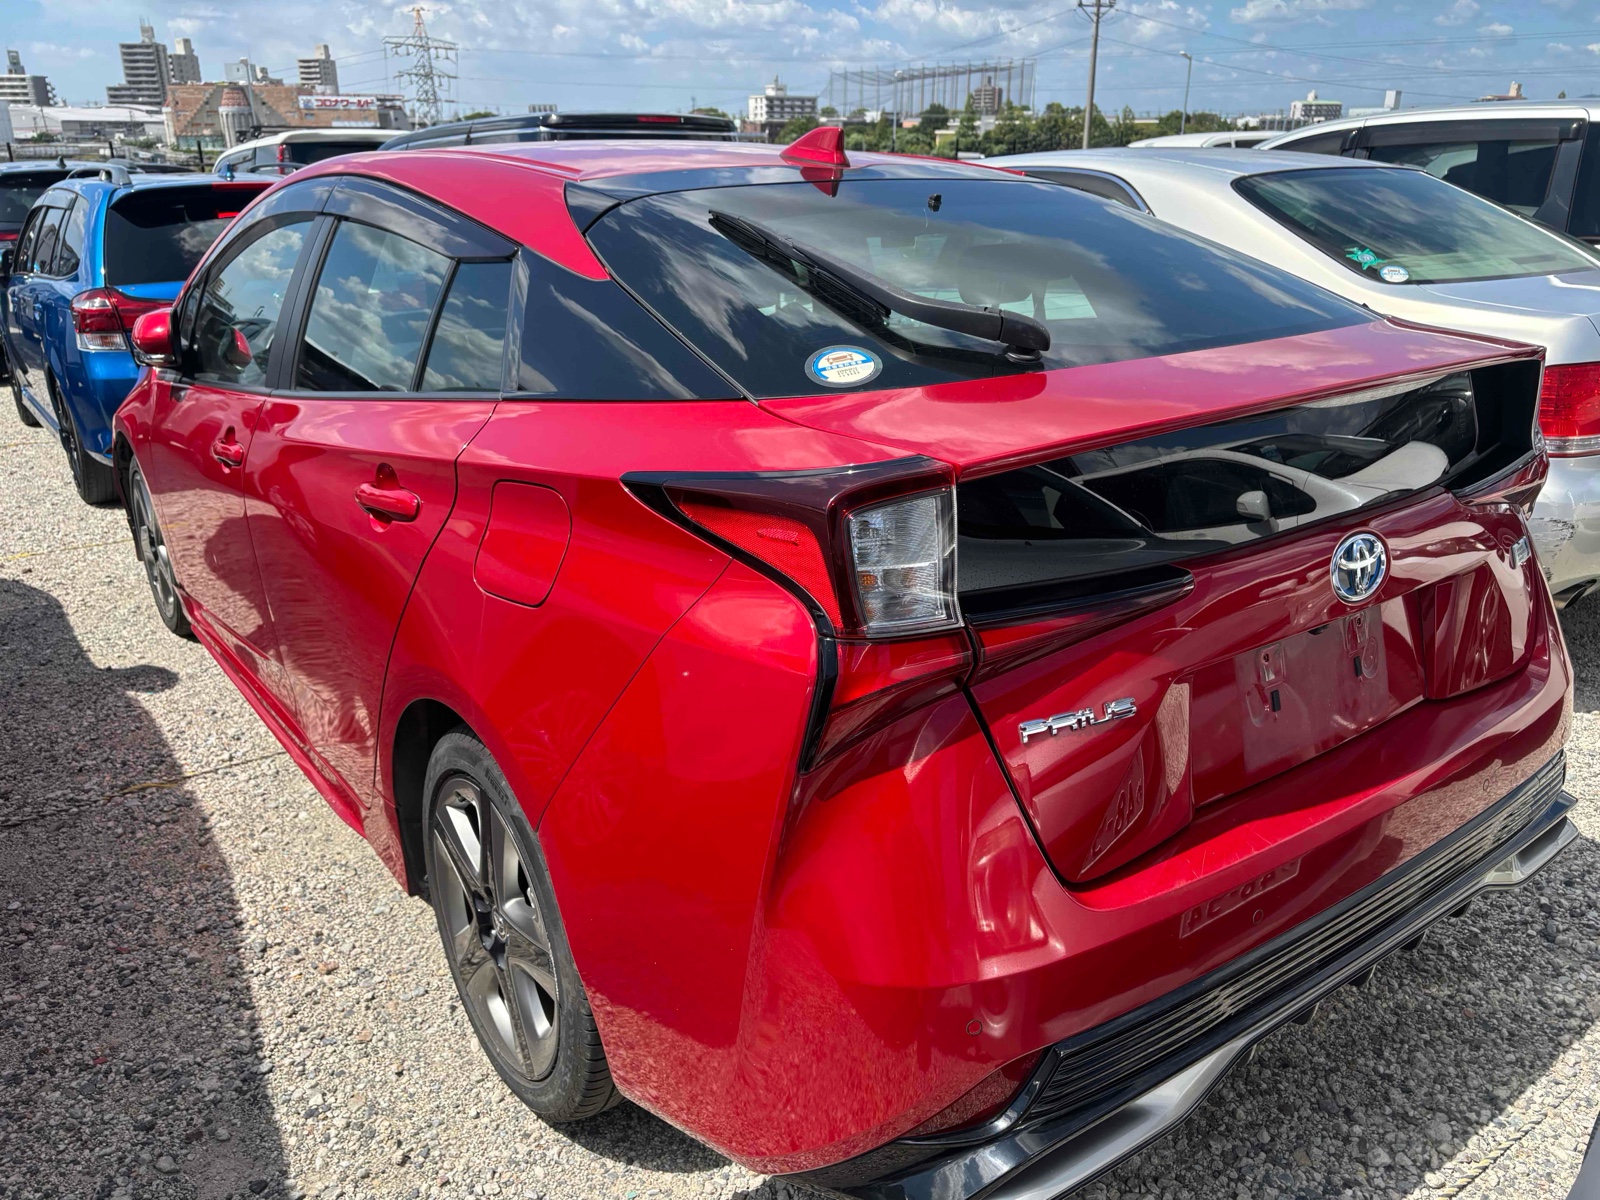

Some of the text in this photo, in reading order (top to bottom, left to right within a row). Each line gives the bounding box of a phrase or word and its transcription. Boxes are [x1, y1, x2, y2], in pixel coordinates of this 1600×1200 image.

[315, 98, 374, 108] コロナワールド
[1018, 697, 1137, 744] PRIUS
[484, 767, 510, 806] PIRELLI
